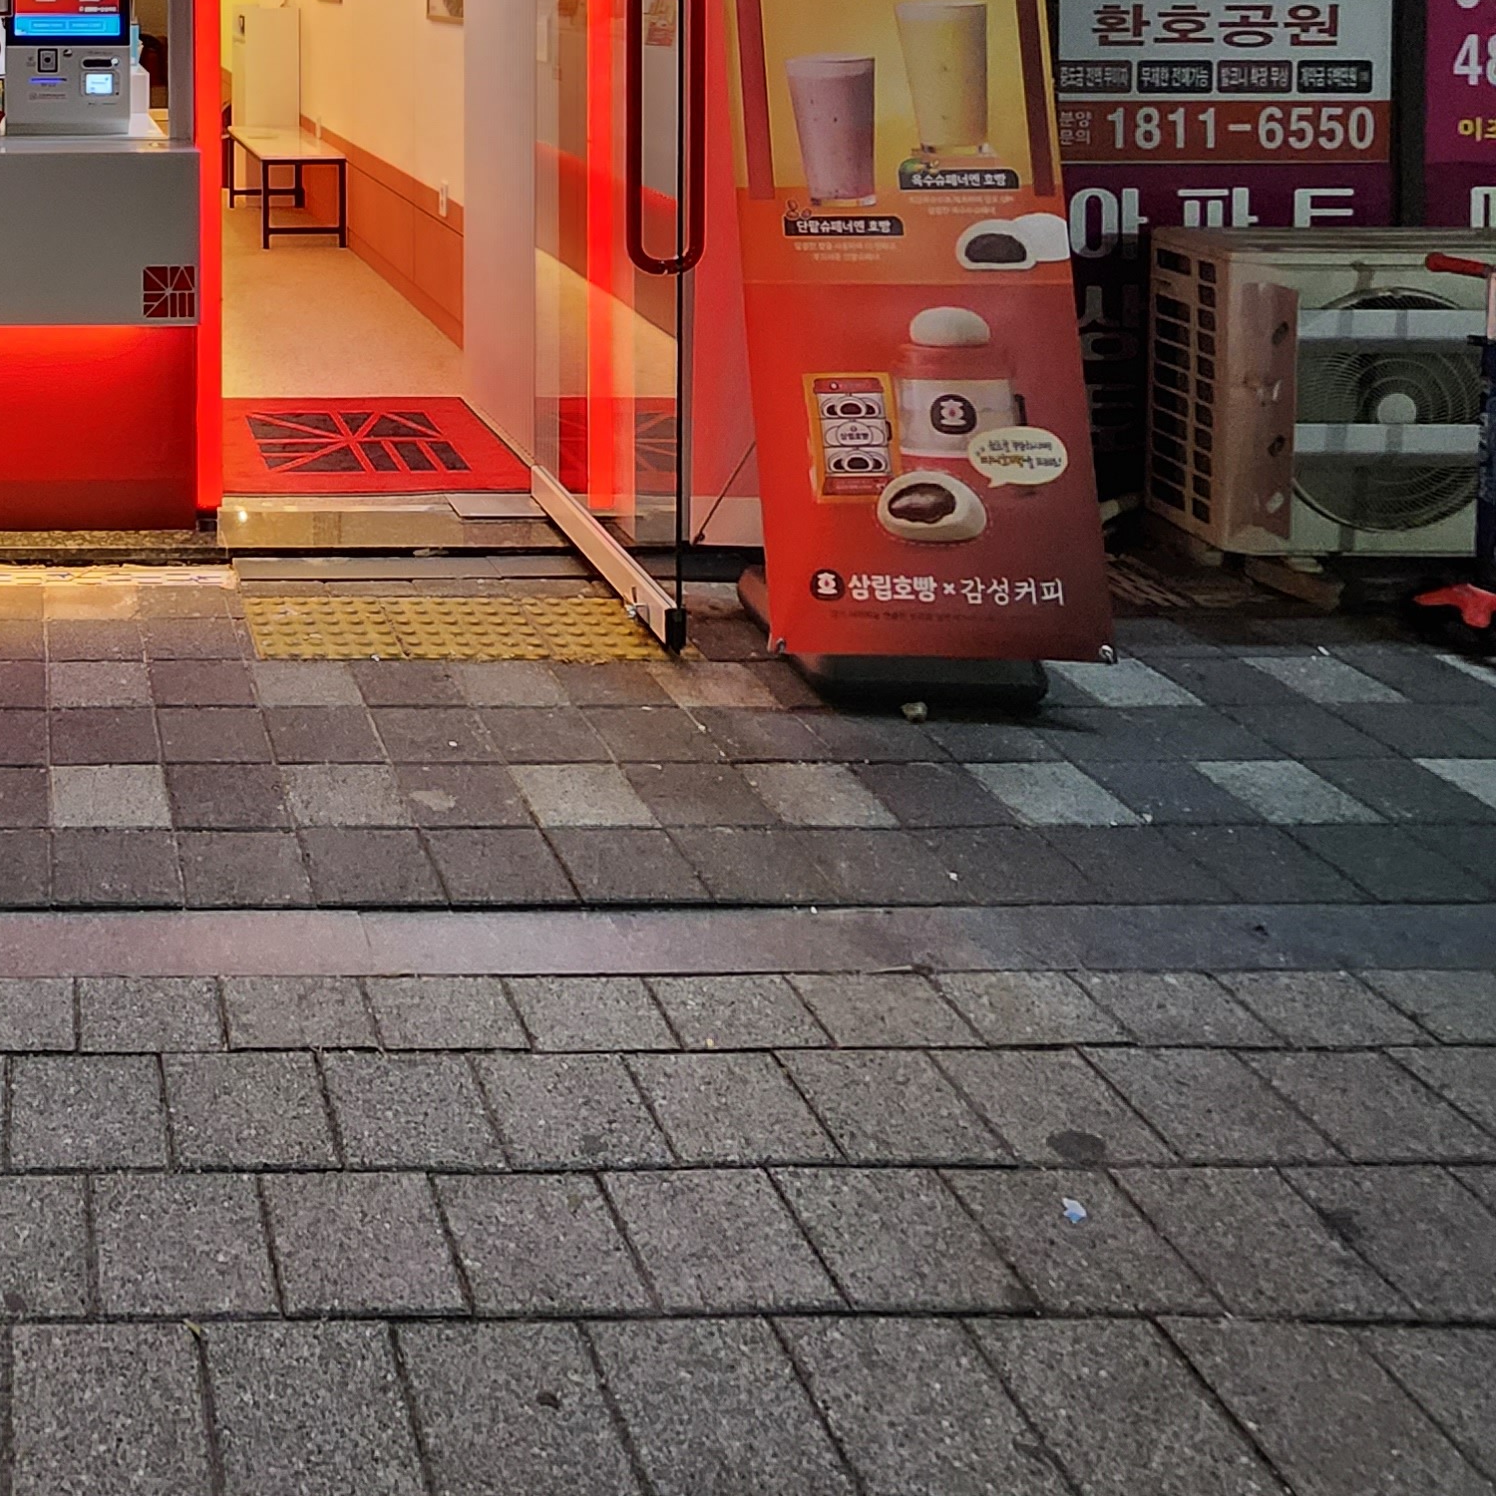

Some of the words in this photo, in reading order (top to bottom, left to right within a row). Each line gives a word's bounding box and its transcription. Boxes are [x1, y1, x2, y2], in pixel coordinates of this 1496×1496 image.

[1092, 3, 1340, 48] 환호공원
[1106, 106, 1375, 150] 1811-6550
[847, 574, 938, 602] 삼립호빵
[959, 576, 1066, 606] 감성커피
